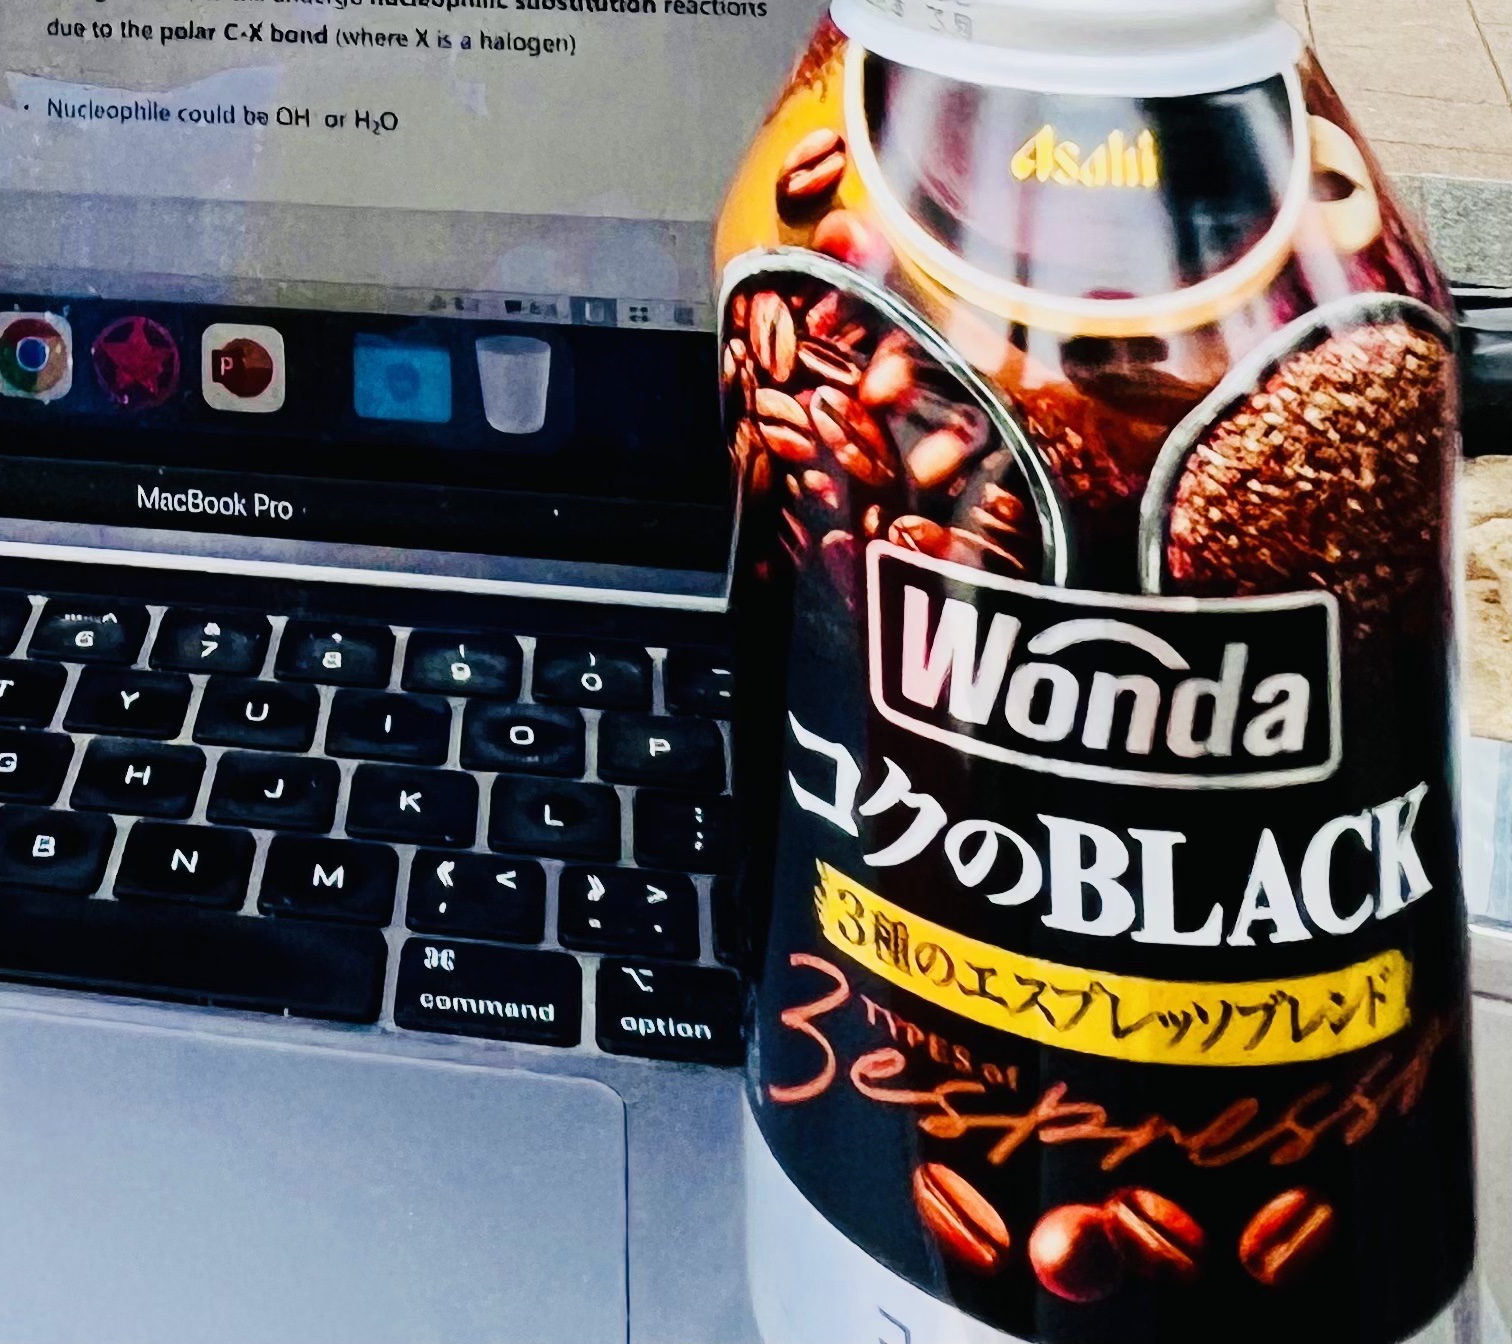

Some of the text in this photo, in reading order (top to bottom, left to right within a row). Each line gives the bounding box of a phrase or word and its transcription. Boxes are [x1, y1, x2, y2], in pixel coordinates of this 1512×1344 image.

[47, 18, 86, 38] due
[92, 21, 113, 39] to
[120, 20, 153, 40] the
[160, 23, 216, 47] polar
[271, 24, 328, 45] bond
[336, 27, 409, 49] (where
[414, 28, 430, 49] X
[437, 29, 452, 49] is
[460, 36, 472, 50] a
[480, 30, 577, 57] halogen)
[47, 98, 171, 125] Nucleophile
[178, 104, 236, 125] could
[243, 106, 270, 126] be
[324, 114, 347, 128] or
[1010, 123, 1161, 189] Asahi
[137, 484, 294, 521] MacBook Pro
[74, 630, 95, 648] 6
[199, 640, 219, 658] 7
[322, 650, 343, 669] 8
[450, 662, 472, 682] 9
[580, 672, 603, 692] 0
[901, 583, 1311, 759] Wonda
[119, 690, 141, 710] Y
[245, 701, 270, 722] U
[508, 724, 536, 746] O
[648, 737, 672, 758] P
[123, 764, 152, 786] H
[263, 777, 285, 799] J
[398, 789, 423, 813] K
[543, 803, 565, 828] L
[787, 711, 1435, 949] コクのBLACK
[31, 834, 56, 858] B
[170, 848, 199, 874] N
[312, 863, 345, 889] M
[419, 992, 556, 1023] command
[619, 1014, 712, 1040] option
